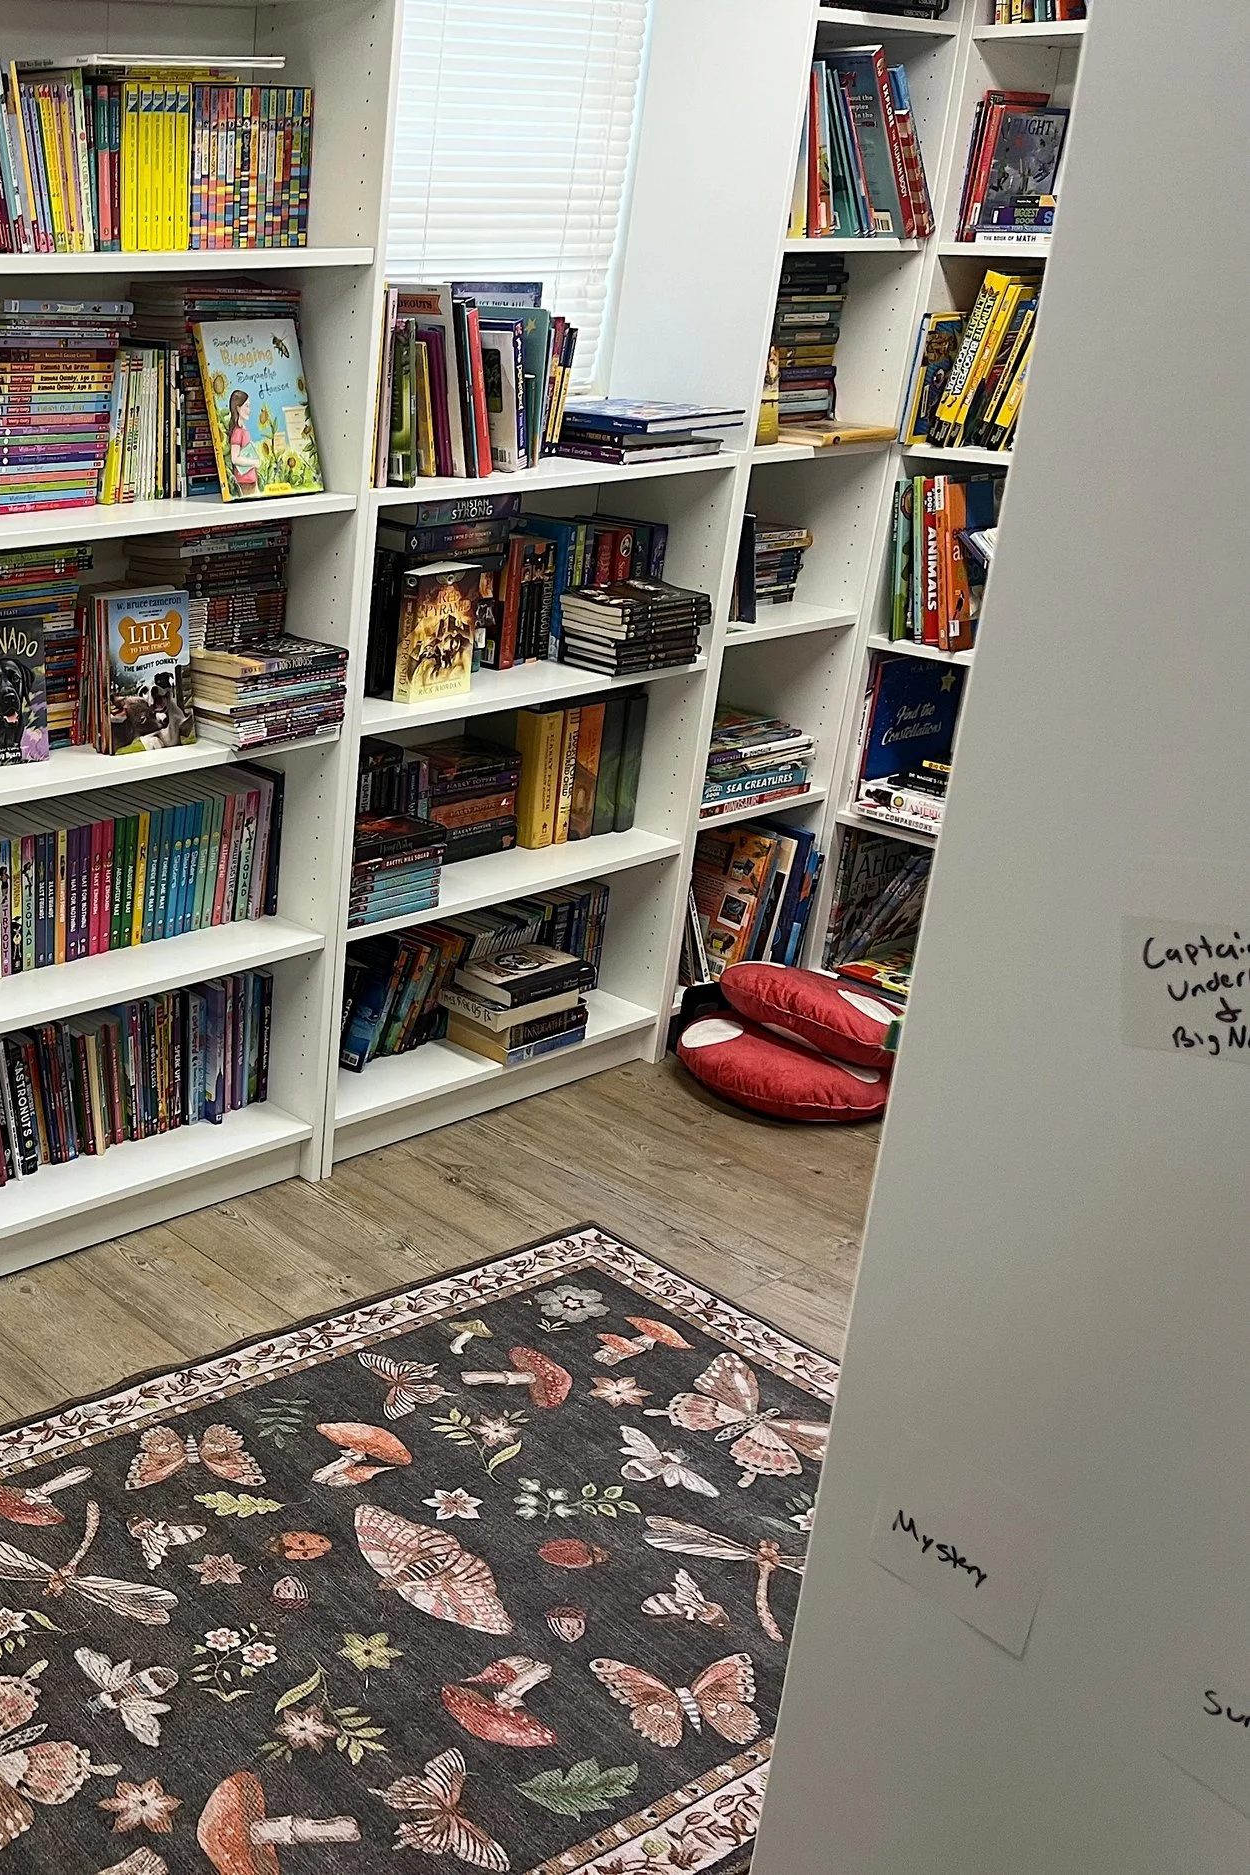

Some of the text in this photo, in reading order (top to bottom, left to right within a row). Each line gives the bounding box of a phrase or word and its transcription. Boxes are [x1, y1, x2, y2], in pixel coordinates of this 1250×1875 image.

[881, 83, 896, 127] EXPLORE
[892, 142, 903, 174] HUMAN
[898, 176, 907, 197] BODY
[1014, 208, 1038, 216] BIGGEST
[213, 335, 246, 348] Something
[944, 291, 986, 392] ULTIMATE BUGOPEDIA
[950, 294, 998, 395] ULTIMATE BUGOPEDIA
[220, 348, 274, 368] Bugging
[237, 367, 277, 383] Samantha
[451, 504, 493, 519] STRONG
[456, 498, 488, 509] TRISTAN
[924, 491, 934, 512] BOOK
[927, 526, 936, 610] ANIMALS
[127, 600, 148, 610] Bruce
[425, 599, 472, 616] PYRAMID
[436, 588, 461, 604] RED
[128, 622, 171, 644] LILY
[156, 658, 178, 666] DONKEY
[398, 639, 409, 684] PYRAMID
[417, 681, 462, 694] RICK RIORDAN
[897, 703, 935, 726] Find the
[882, 722, 942, 746] Constellations
[5, 750, 21, 758] Byars
[546, 734, 554, 769] HARRY
[563, 750, 571, 774] CURSED
[725, 772, 794, 793] SEA CREATURES
[866, 807, 878, 816] BOOK
[884, 813, 932, 832] COMPARISONS
[179, 852, 190, 886] Sisters
[188, 850, 198, 884] Sisters
[198, 848, 207, 874] Smile
[208, 845, 218, 871] Smile
[385, 851, 430, 866] DACTYL HILL SQUAD
[170, 854, 180, 889] Sisters
[240, 855, 249, 896] SQUAD
[1143, 932, 1250, 969] Captai
[1167, 971, 1250, 1002] Under
[1172, 1025, 1250, 1056] Big N
[12, 1067, 32, 1137] ASTRONUTS
[892, 1510, 988, 1588] Mystery
